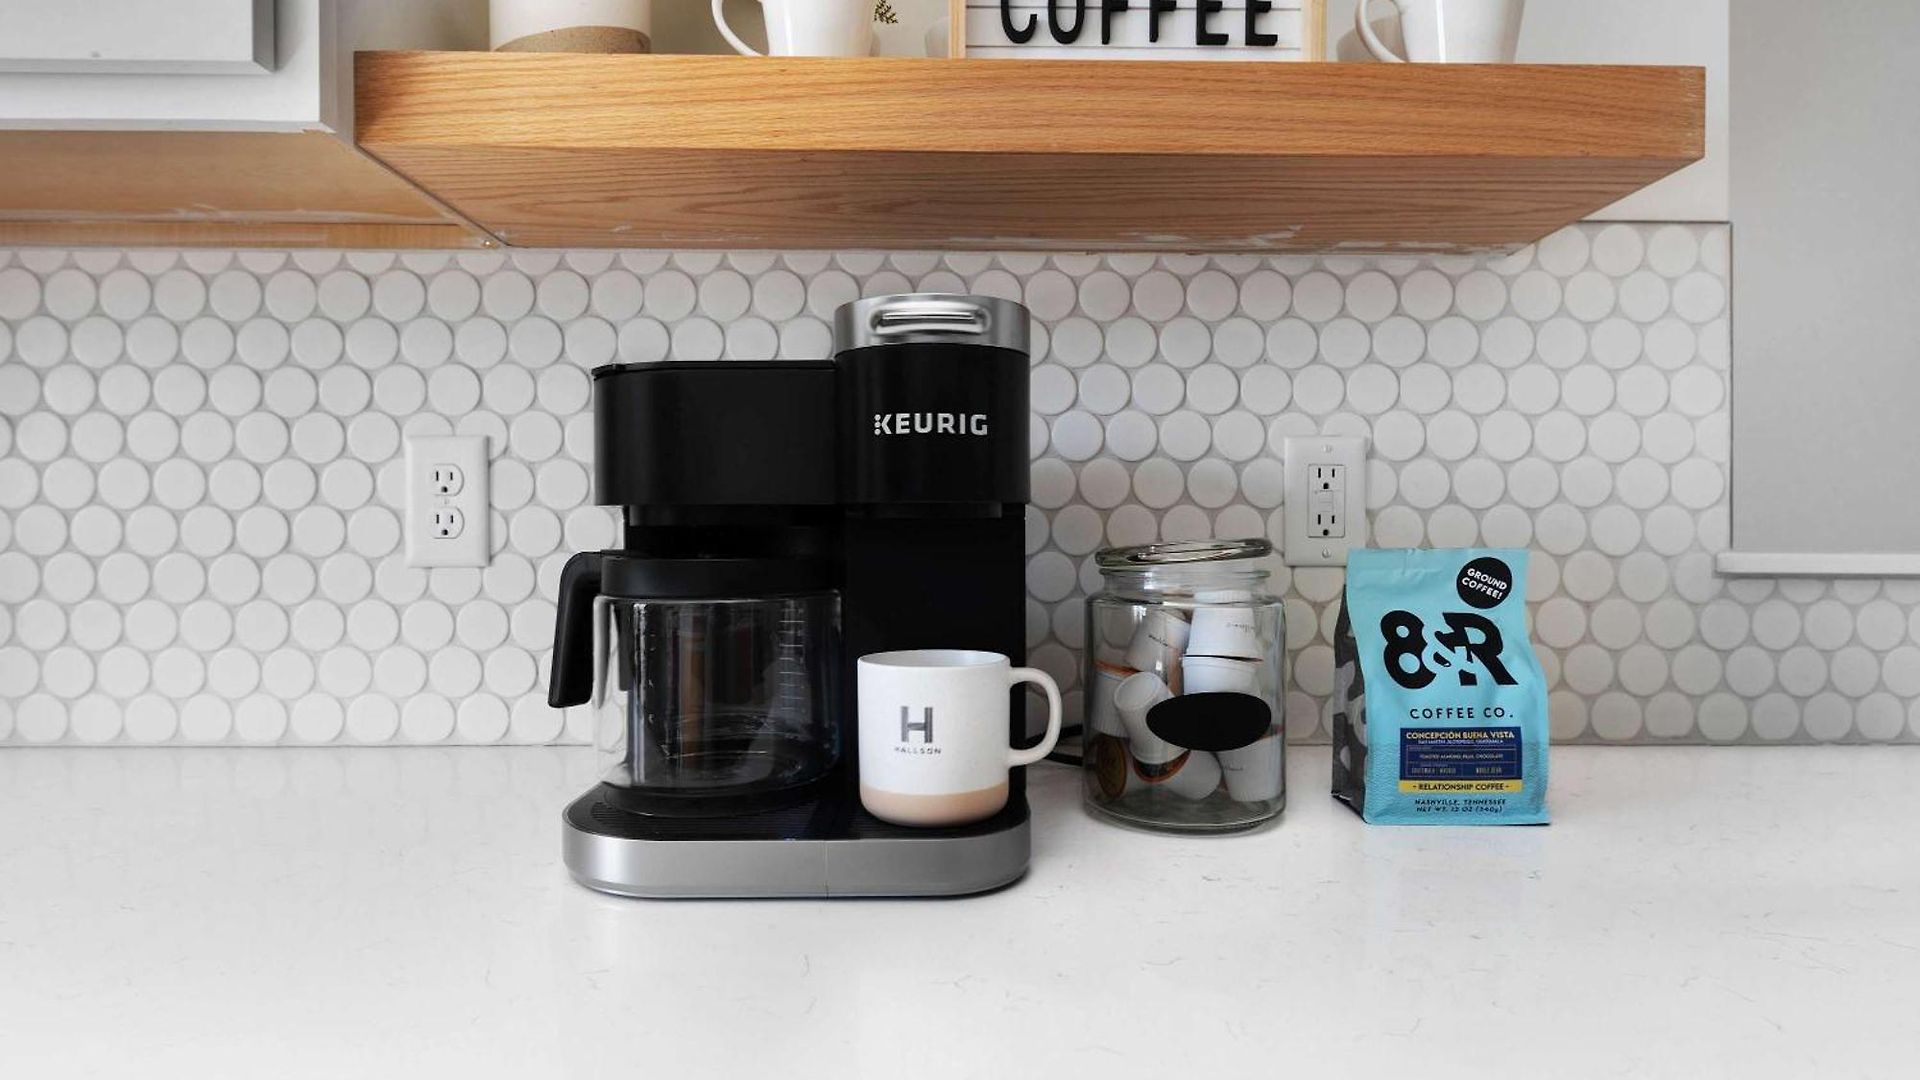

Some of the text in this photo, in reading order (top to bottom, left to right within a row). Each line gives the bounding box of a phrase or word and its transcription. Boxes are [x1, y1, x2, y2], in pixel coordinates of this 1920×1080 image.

[1001, 0, 1278, 46] COFFEE
[874, 413, 988, 435] KEURIG
[1461, 577, 1504, 600] COFFEE!
[1466, 568, 1508, 590] GROUND
[1409, 707, 1514, 719] COFFEE CO.
[901, 706, 934, 743] H
[1462, 731, 1489, 739] BUENA
[1490, 731, 1516, 739] VISTA
[1419, 783, 1505, 791] RELATIONSHIP COFFEE
